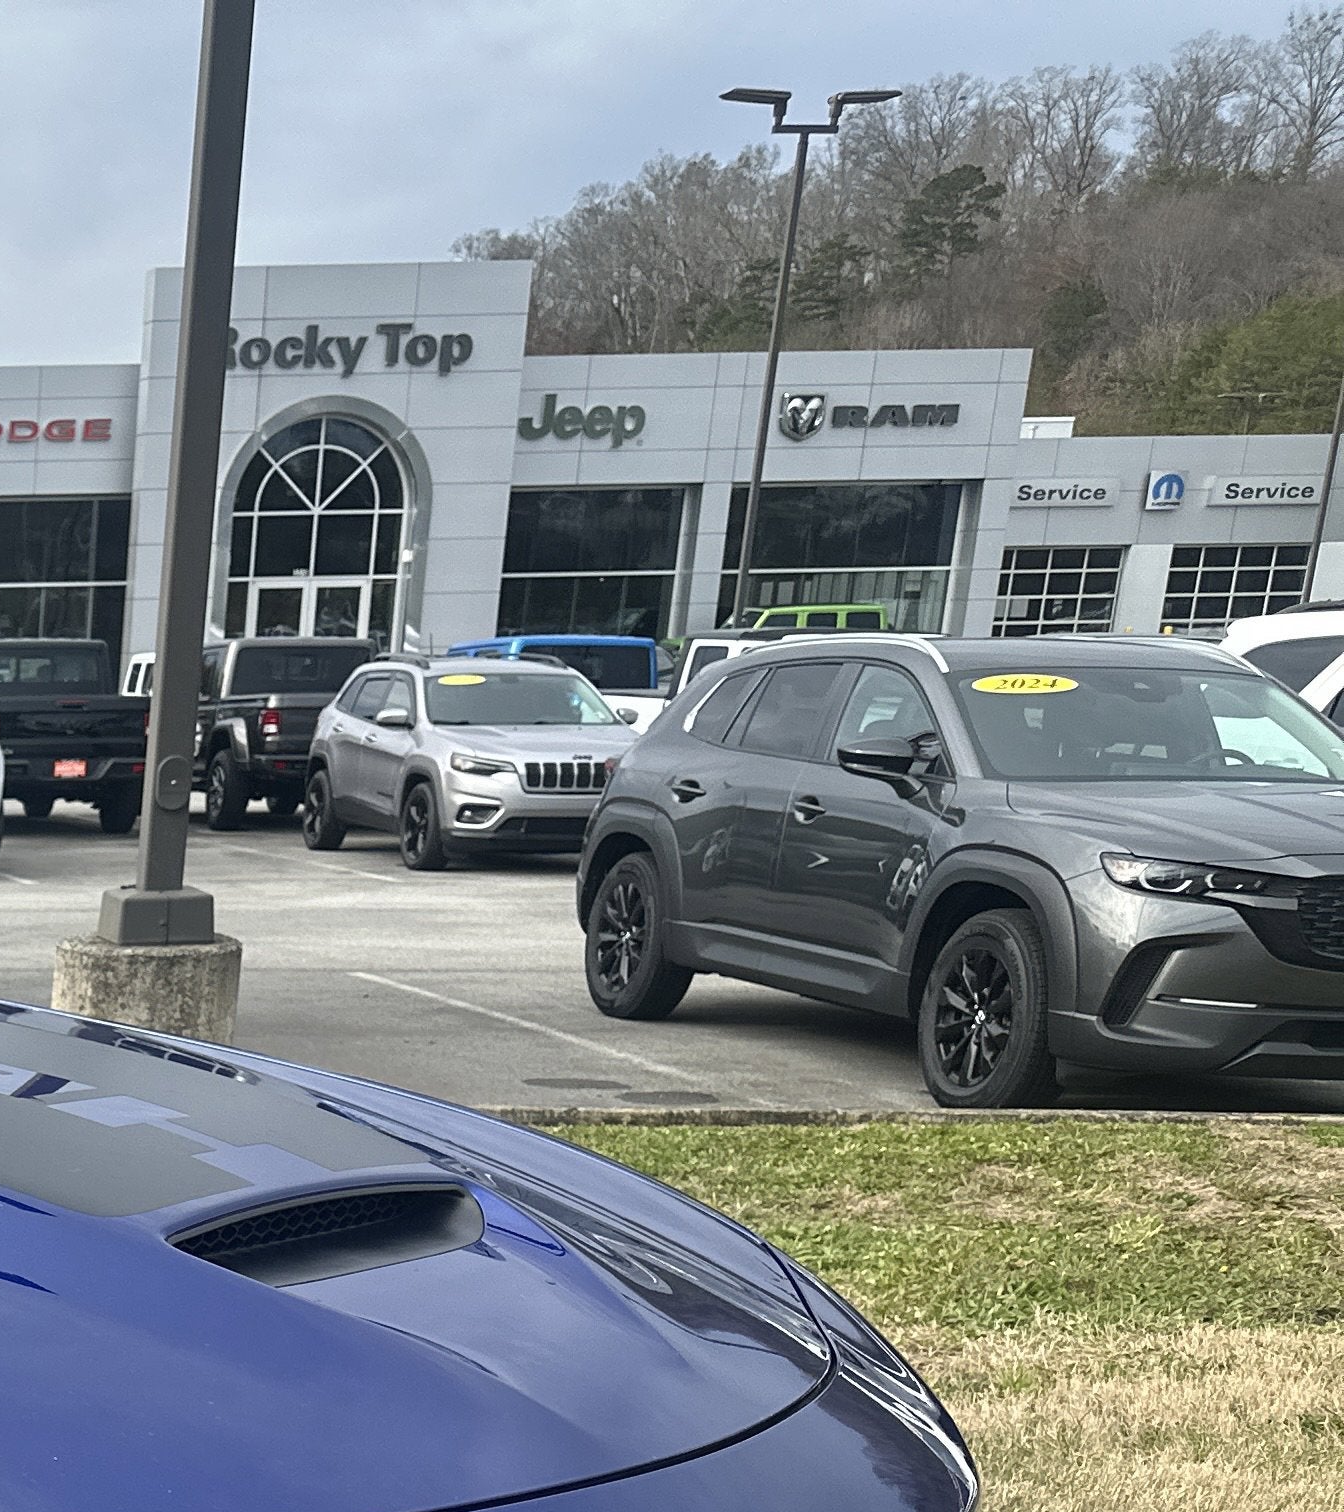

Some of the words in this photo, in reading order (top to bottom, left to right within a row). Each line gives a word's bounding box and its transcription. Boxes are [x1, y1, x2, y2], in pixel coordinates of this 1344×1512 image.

[376, 323, 473, 377] Top
[517, 393, 646, 449] Jeep
[832, 404, 960, 428] RAM
[1017, 484, 1107, 501] Service
[1225, 482, 1315, 499] Service
[994, 678, 1059, 690] 2024
